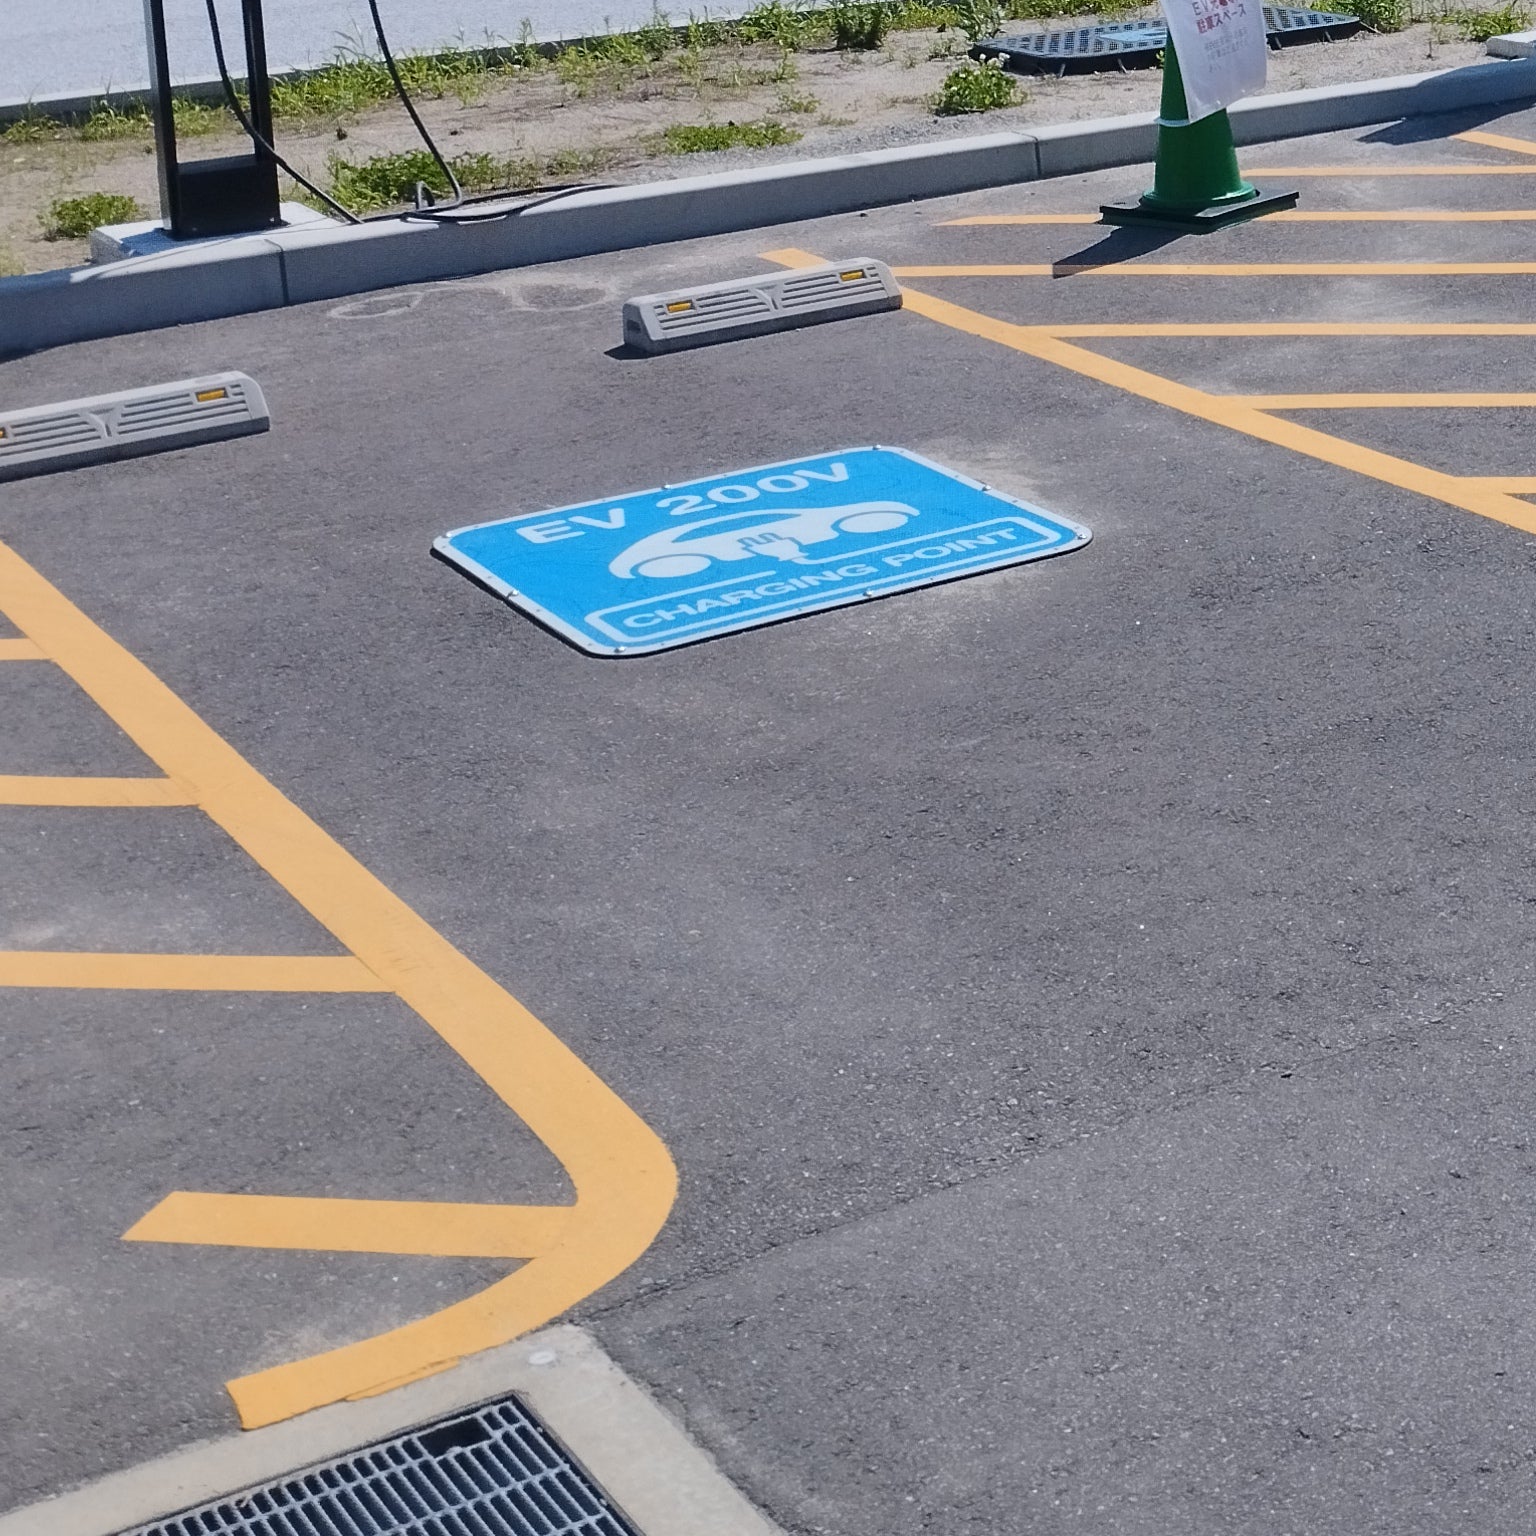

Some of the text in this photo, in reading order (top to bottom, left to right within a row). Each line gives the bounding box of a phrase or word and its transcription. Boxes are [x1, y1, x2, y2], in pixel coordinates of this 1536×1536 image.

[516, 462, 855, 545] EV 200V
[622, 527, 1020, 629] CHARGING POINT
